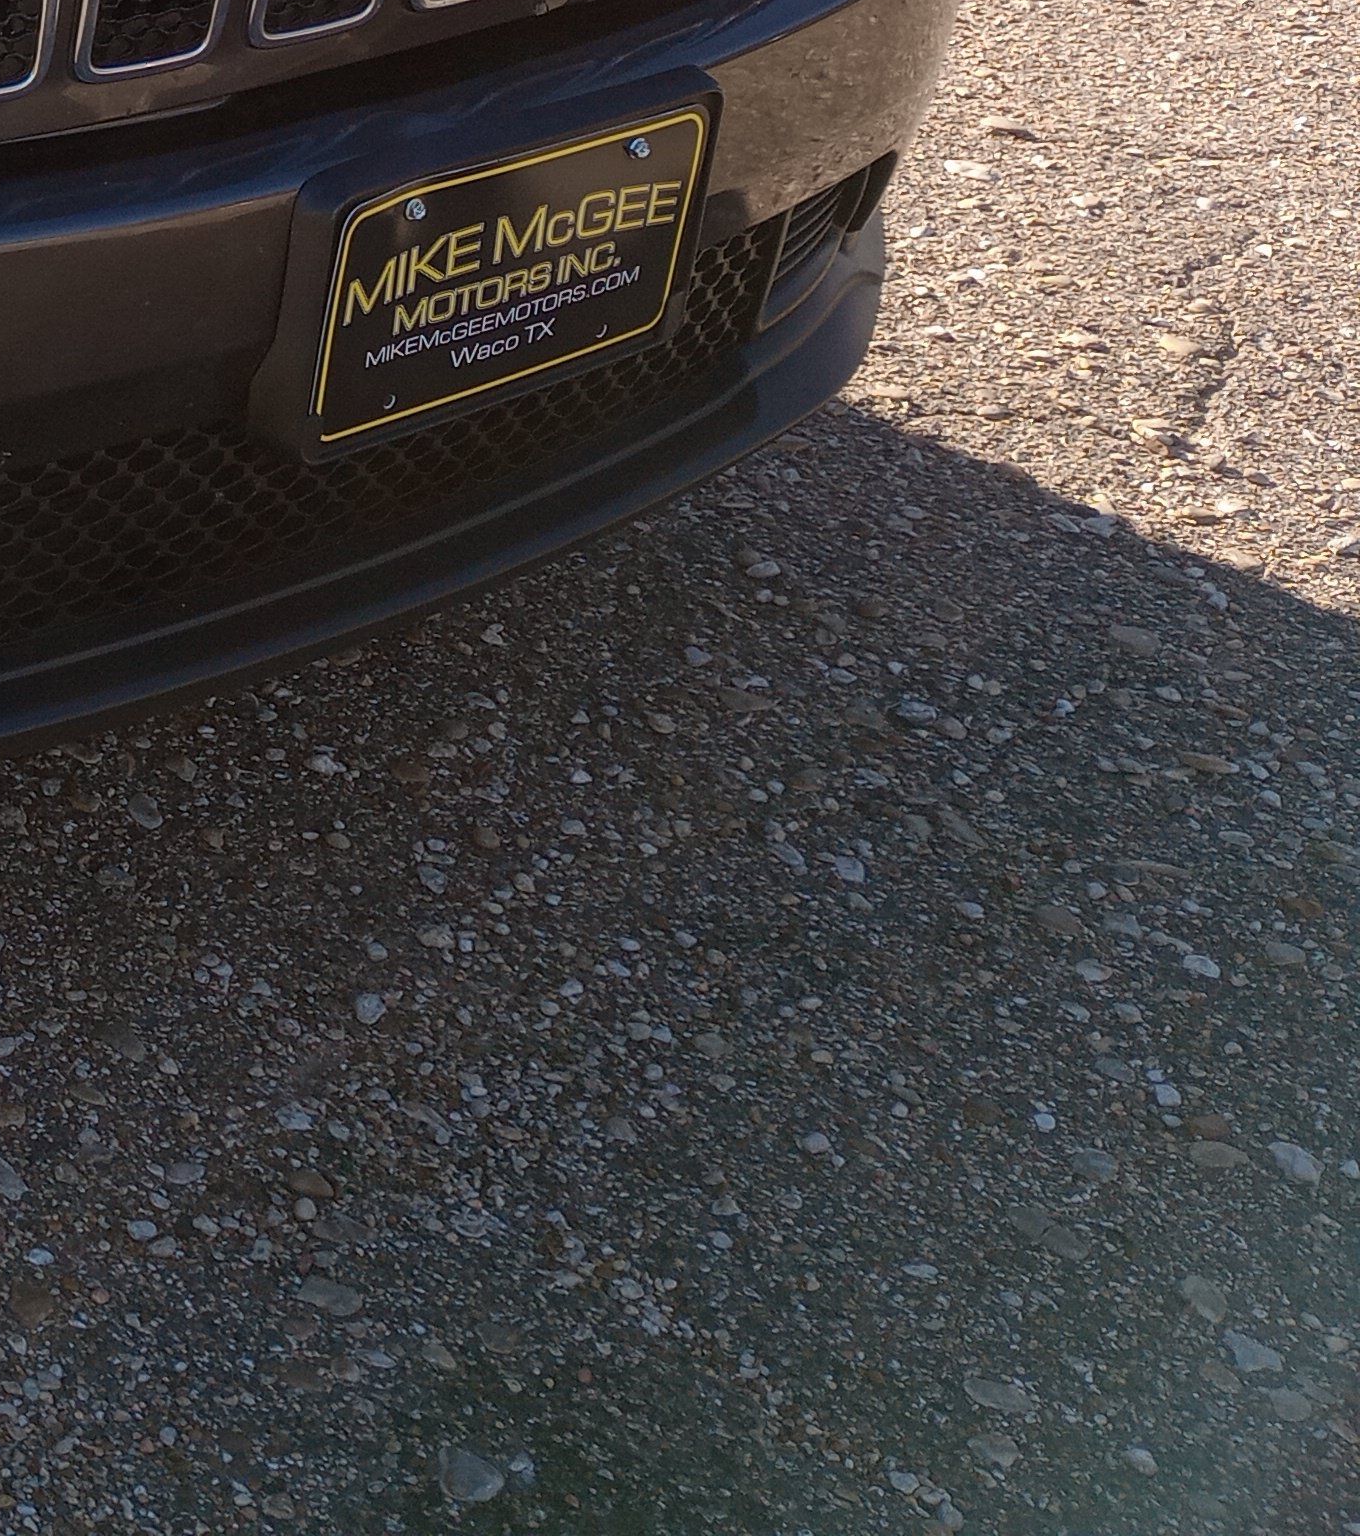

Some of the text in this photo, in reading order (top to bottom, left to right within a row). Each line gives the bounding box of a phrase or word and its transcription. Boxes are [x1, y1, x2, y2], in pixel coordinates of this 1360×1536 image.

[342, 180, 682, 326] MIKE McGEE
[392, 241, 623, 336] MOTORS INC.
[364, 265, 642, 369] MIKEMcGEEMOTORS.COM
[450, 318, 555, 368] Waco TX
